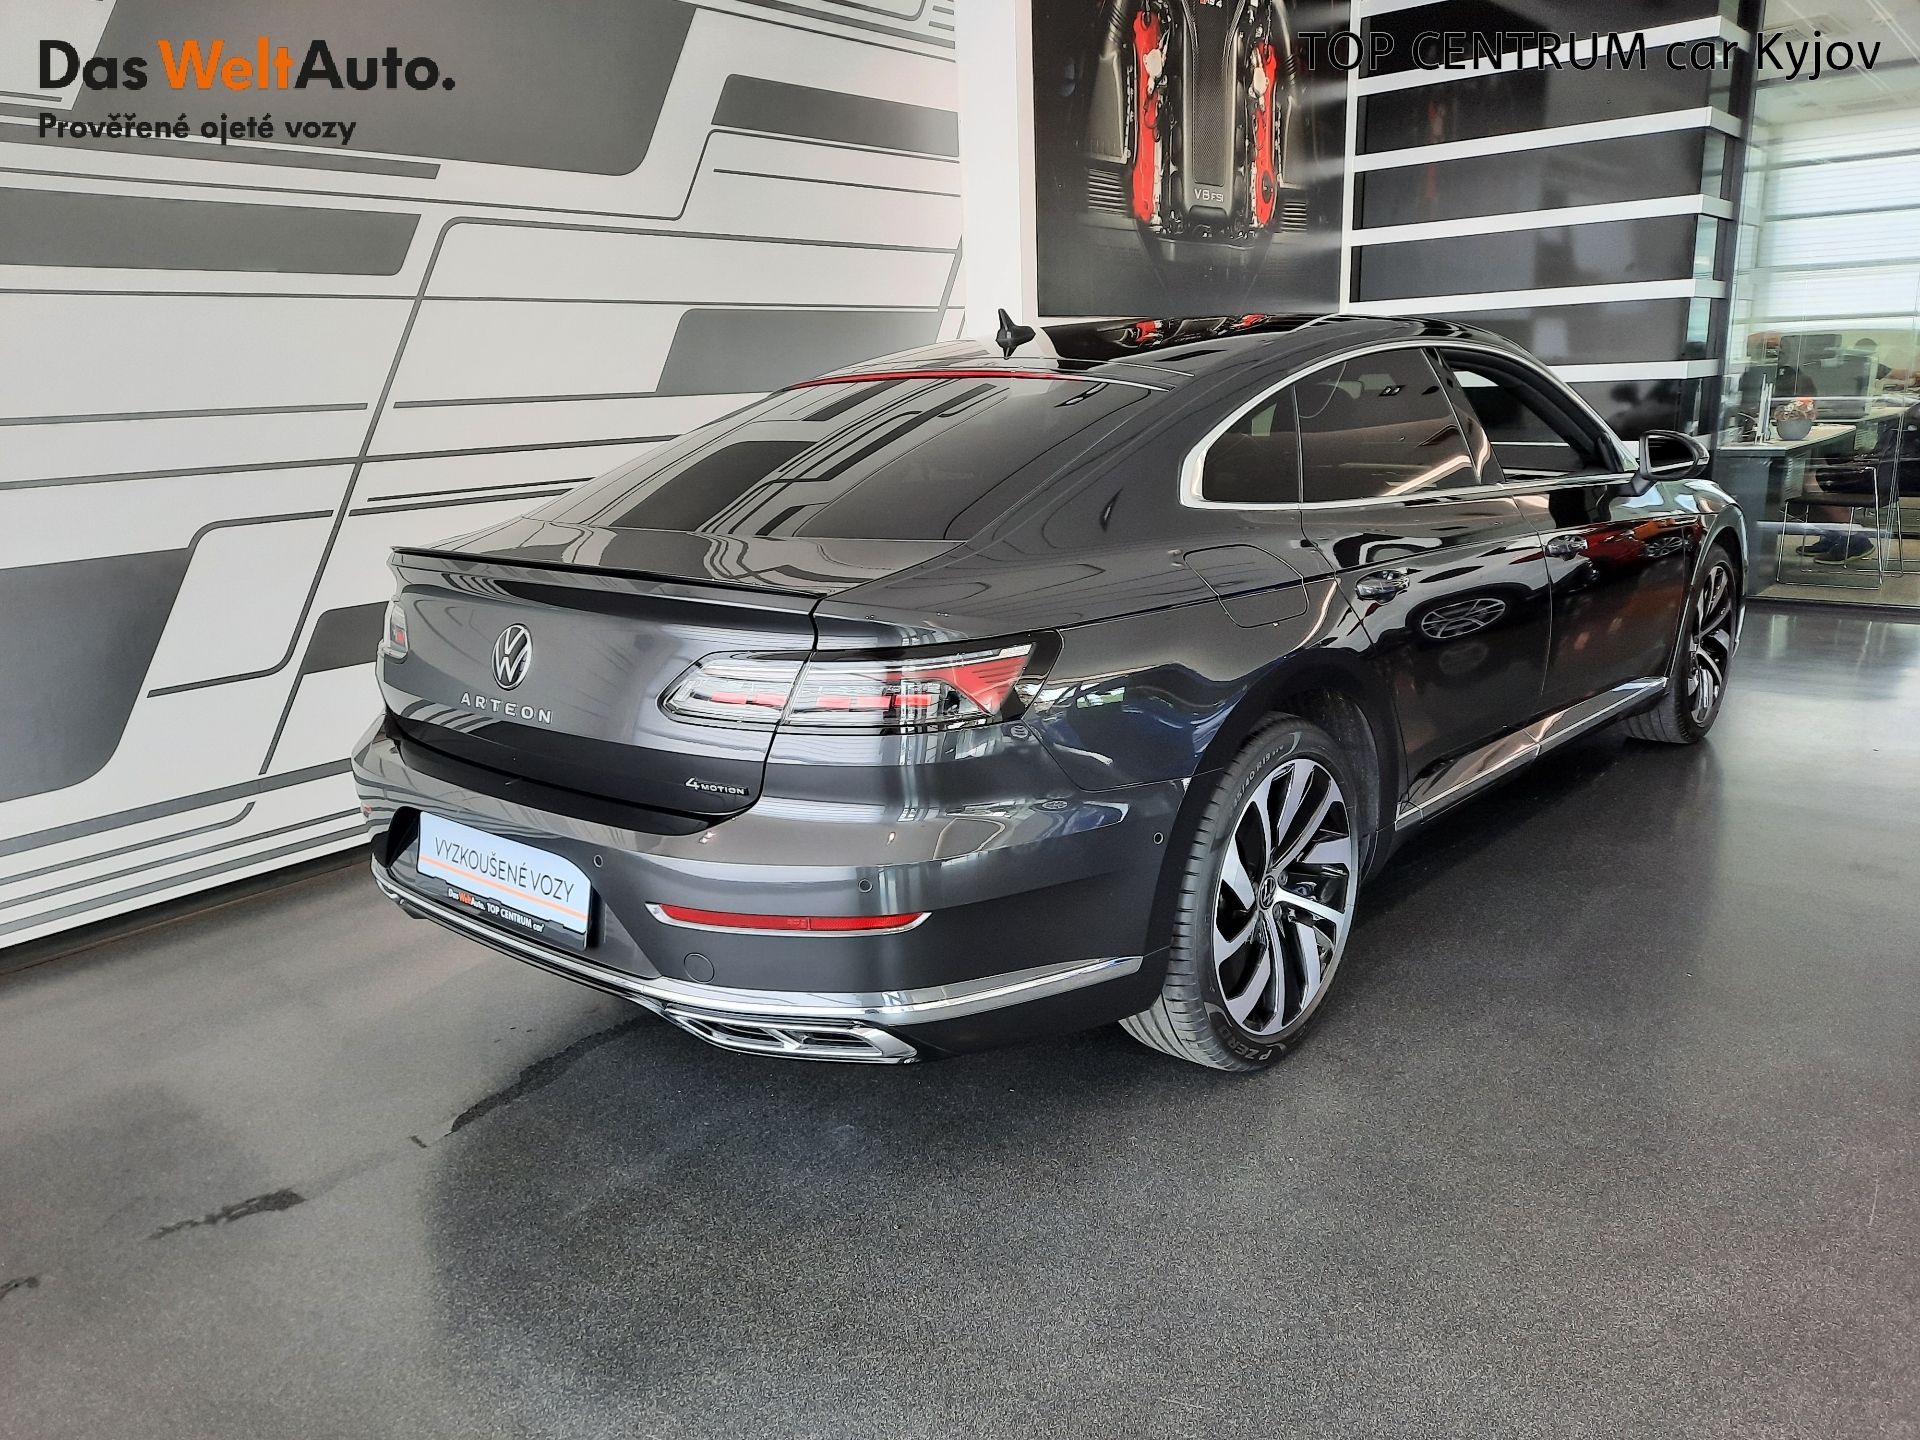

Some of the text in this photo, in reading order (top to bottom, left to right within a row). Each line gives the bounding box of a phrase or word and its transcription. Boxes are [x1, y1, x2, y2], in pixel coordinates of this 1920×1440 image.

[460, 692, 552, 724] ARTEON
[685, 777, 745, 795] 4MOTION
[435, 836, 575, 903] VYZKOUŠENÉ VOZY
[486, 902, 500, 916] TOP
[500, 908, 532, 929] CENTRUM
